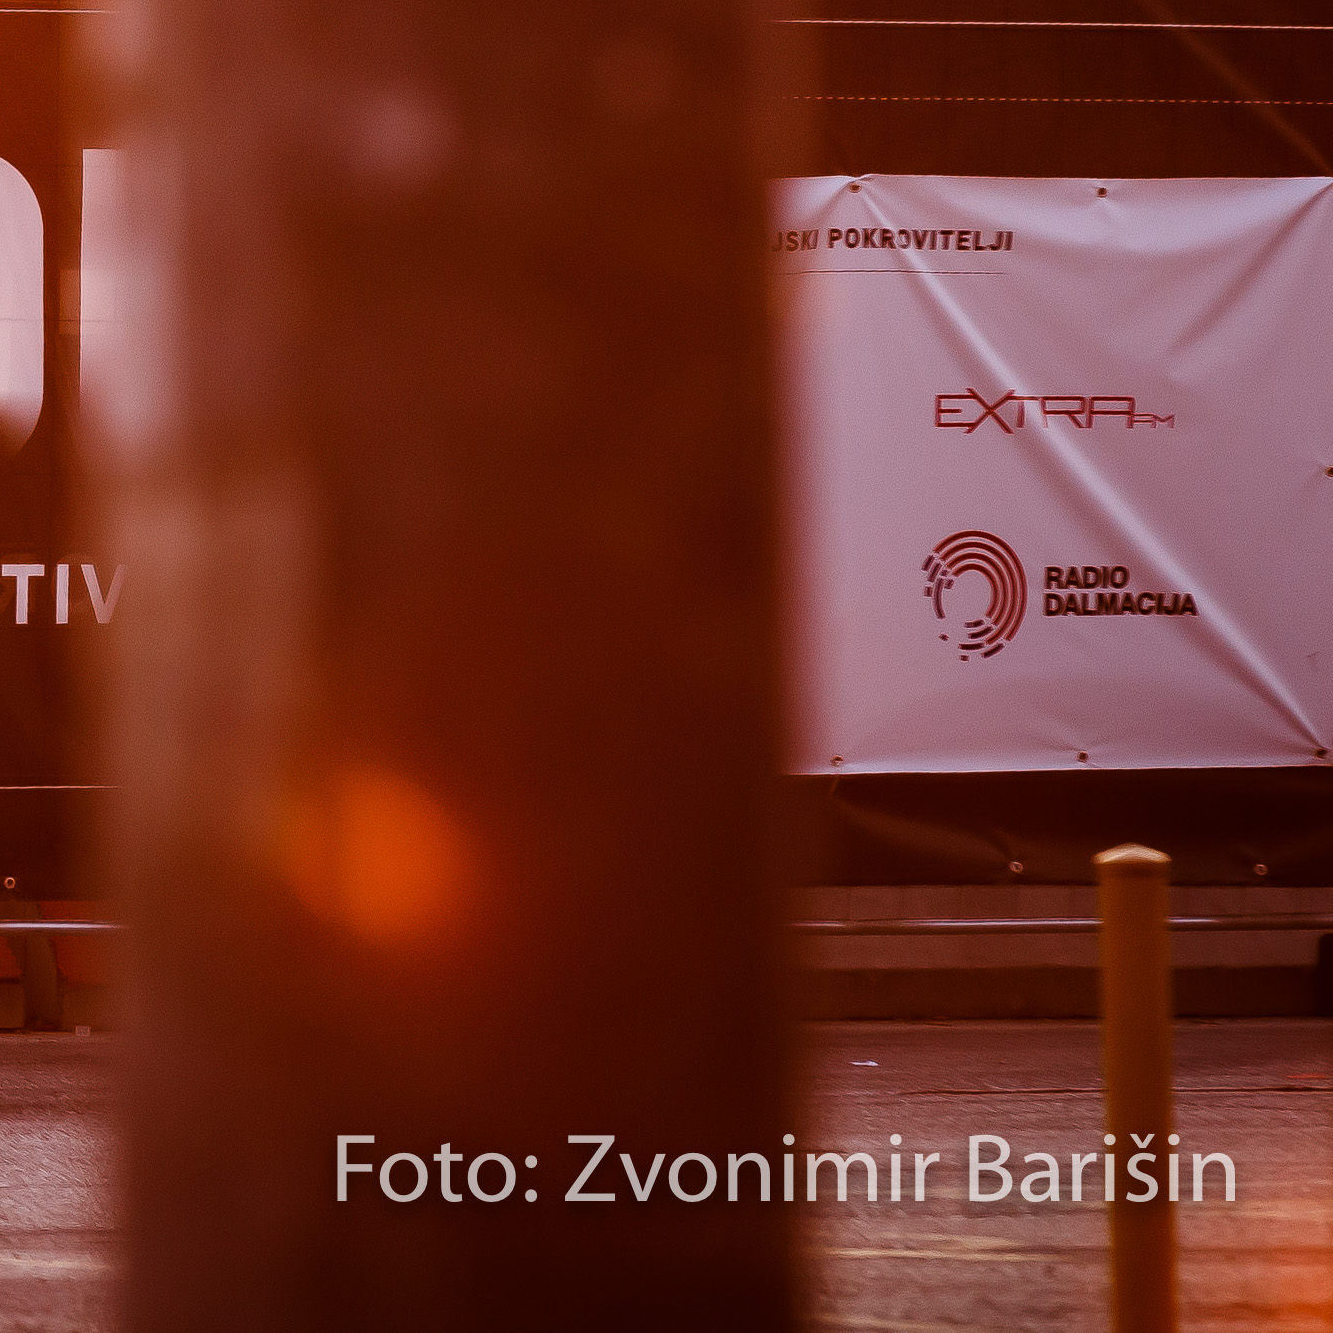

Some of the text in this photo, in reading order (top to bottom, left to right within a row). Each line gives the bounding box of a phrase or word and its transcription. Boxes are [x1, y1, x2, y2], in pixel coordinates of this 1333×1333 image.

[771, 227, 1015, 252] JSKI POKROVITELJI
[1043, 566, 1130, 590] RADIO
[1043, 592, 1199, 617] DALMACIJA
